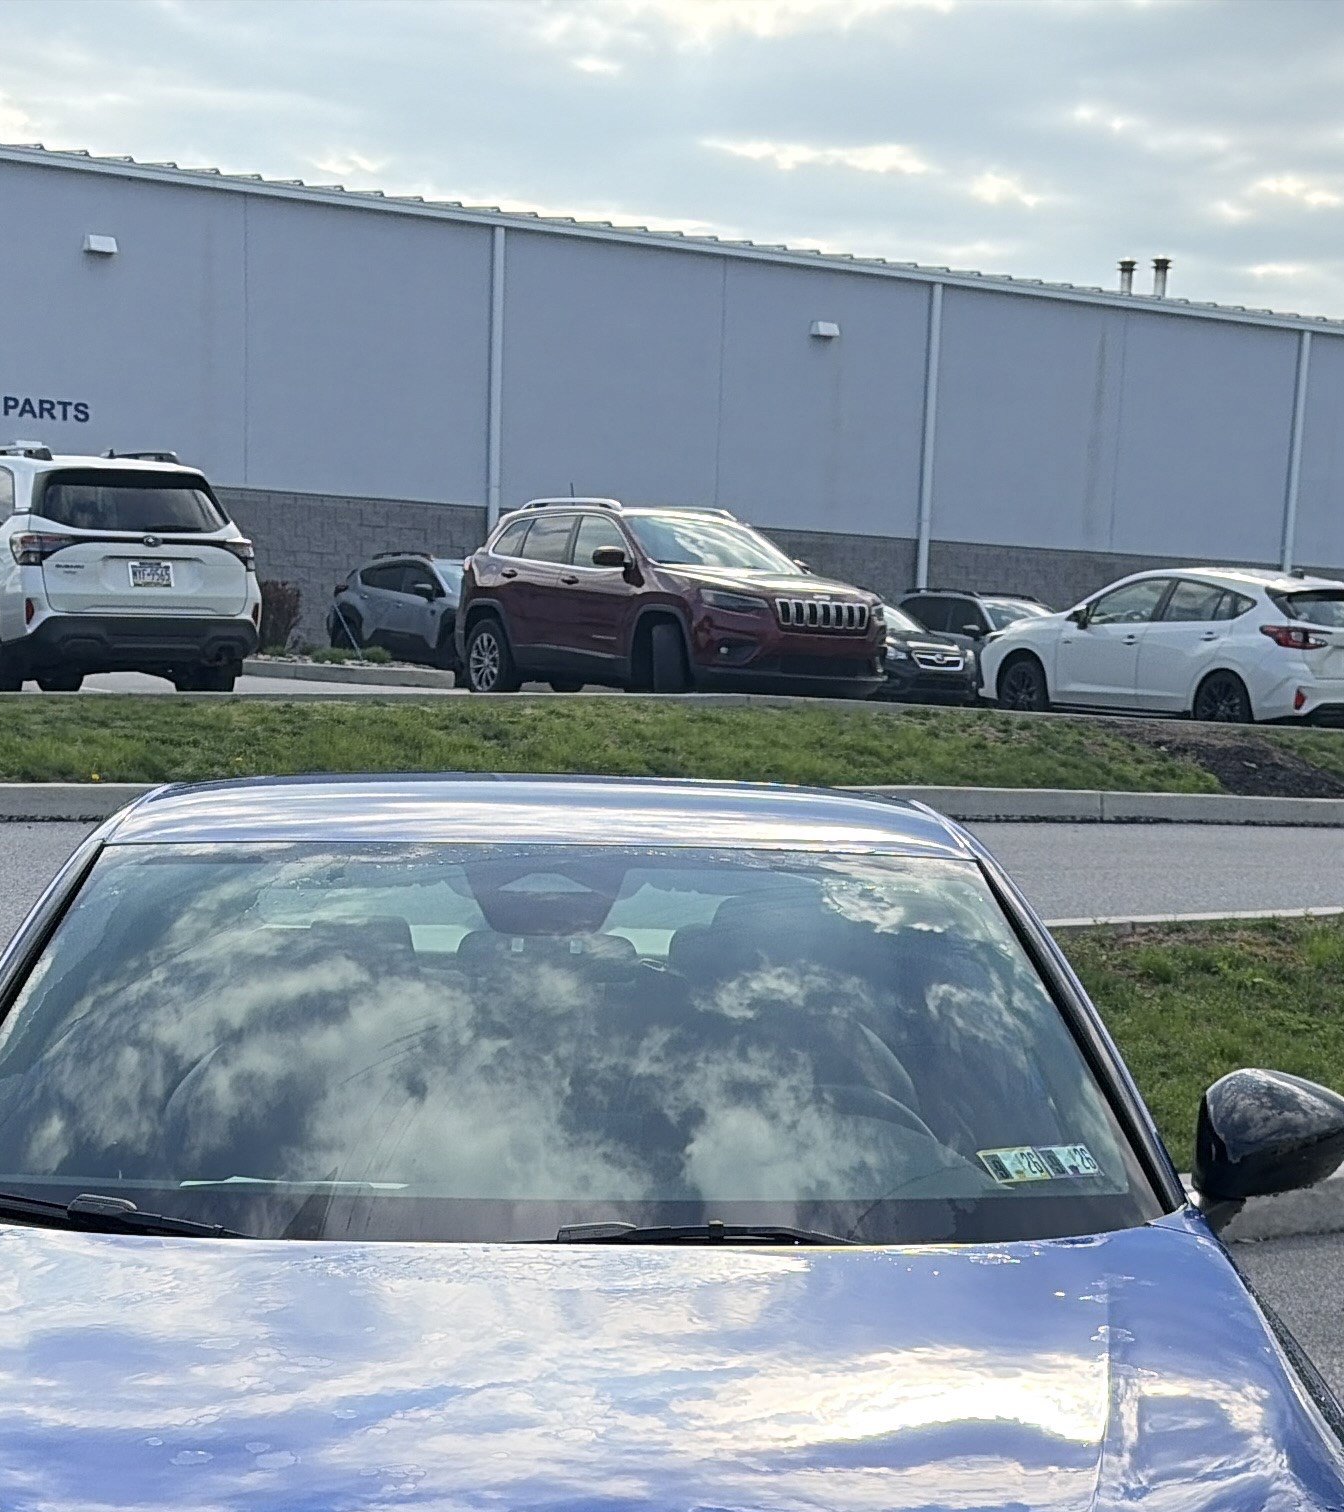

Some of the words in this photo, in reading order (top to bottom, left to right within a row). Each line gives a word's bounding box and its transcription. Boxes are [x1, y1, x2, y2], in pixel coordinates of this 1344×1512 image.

[3, 396, 90, 423] PARTS
[1020, 1152, 1045, 1174] 26
[1073, 1147, 1097, 1170] 26
